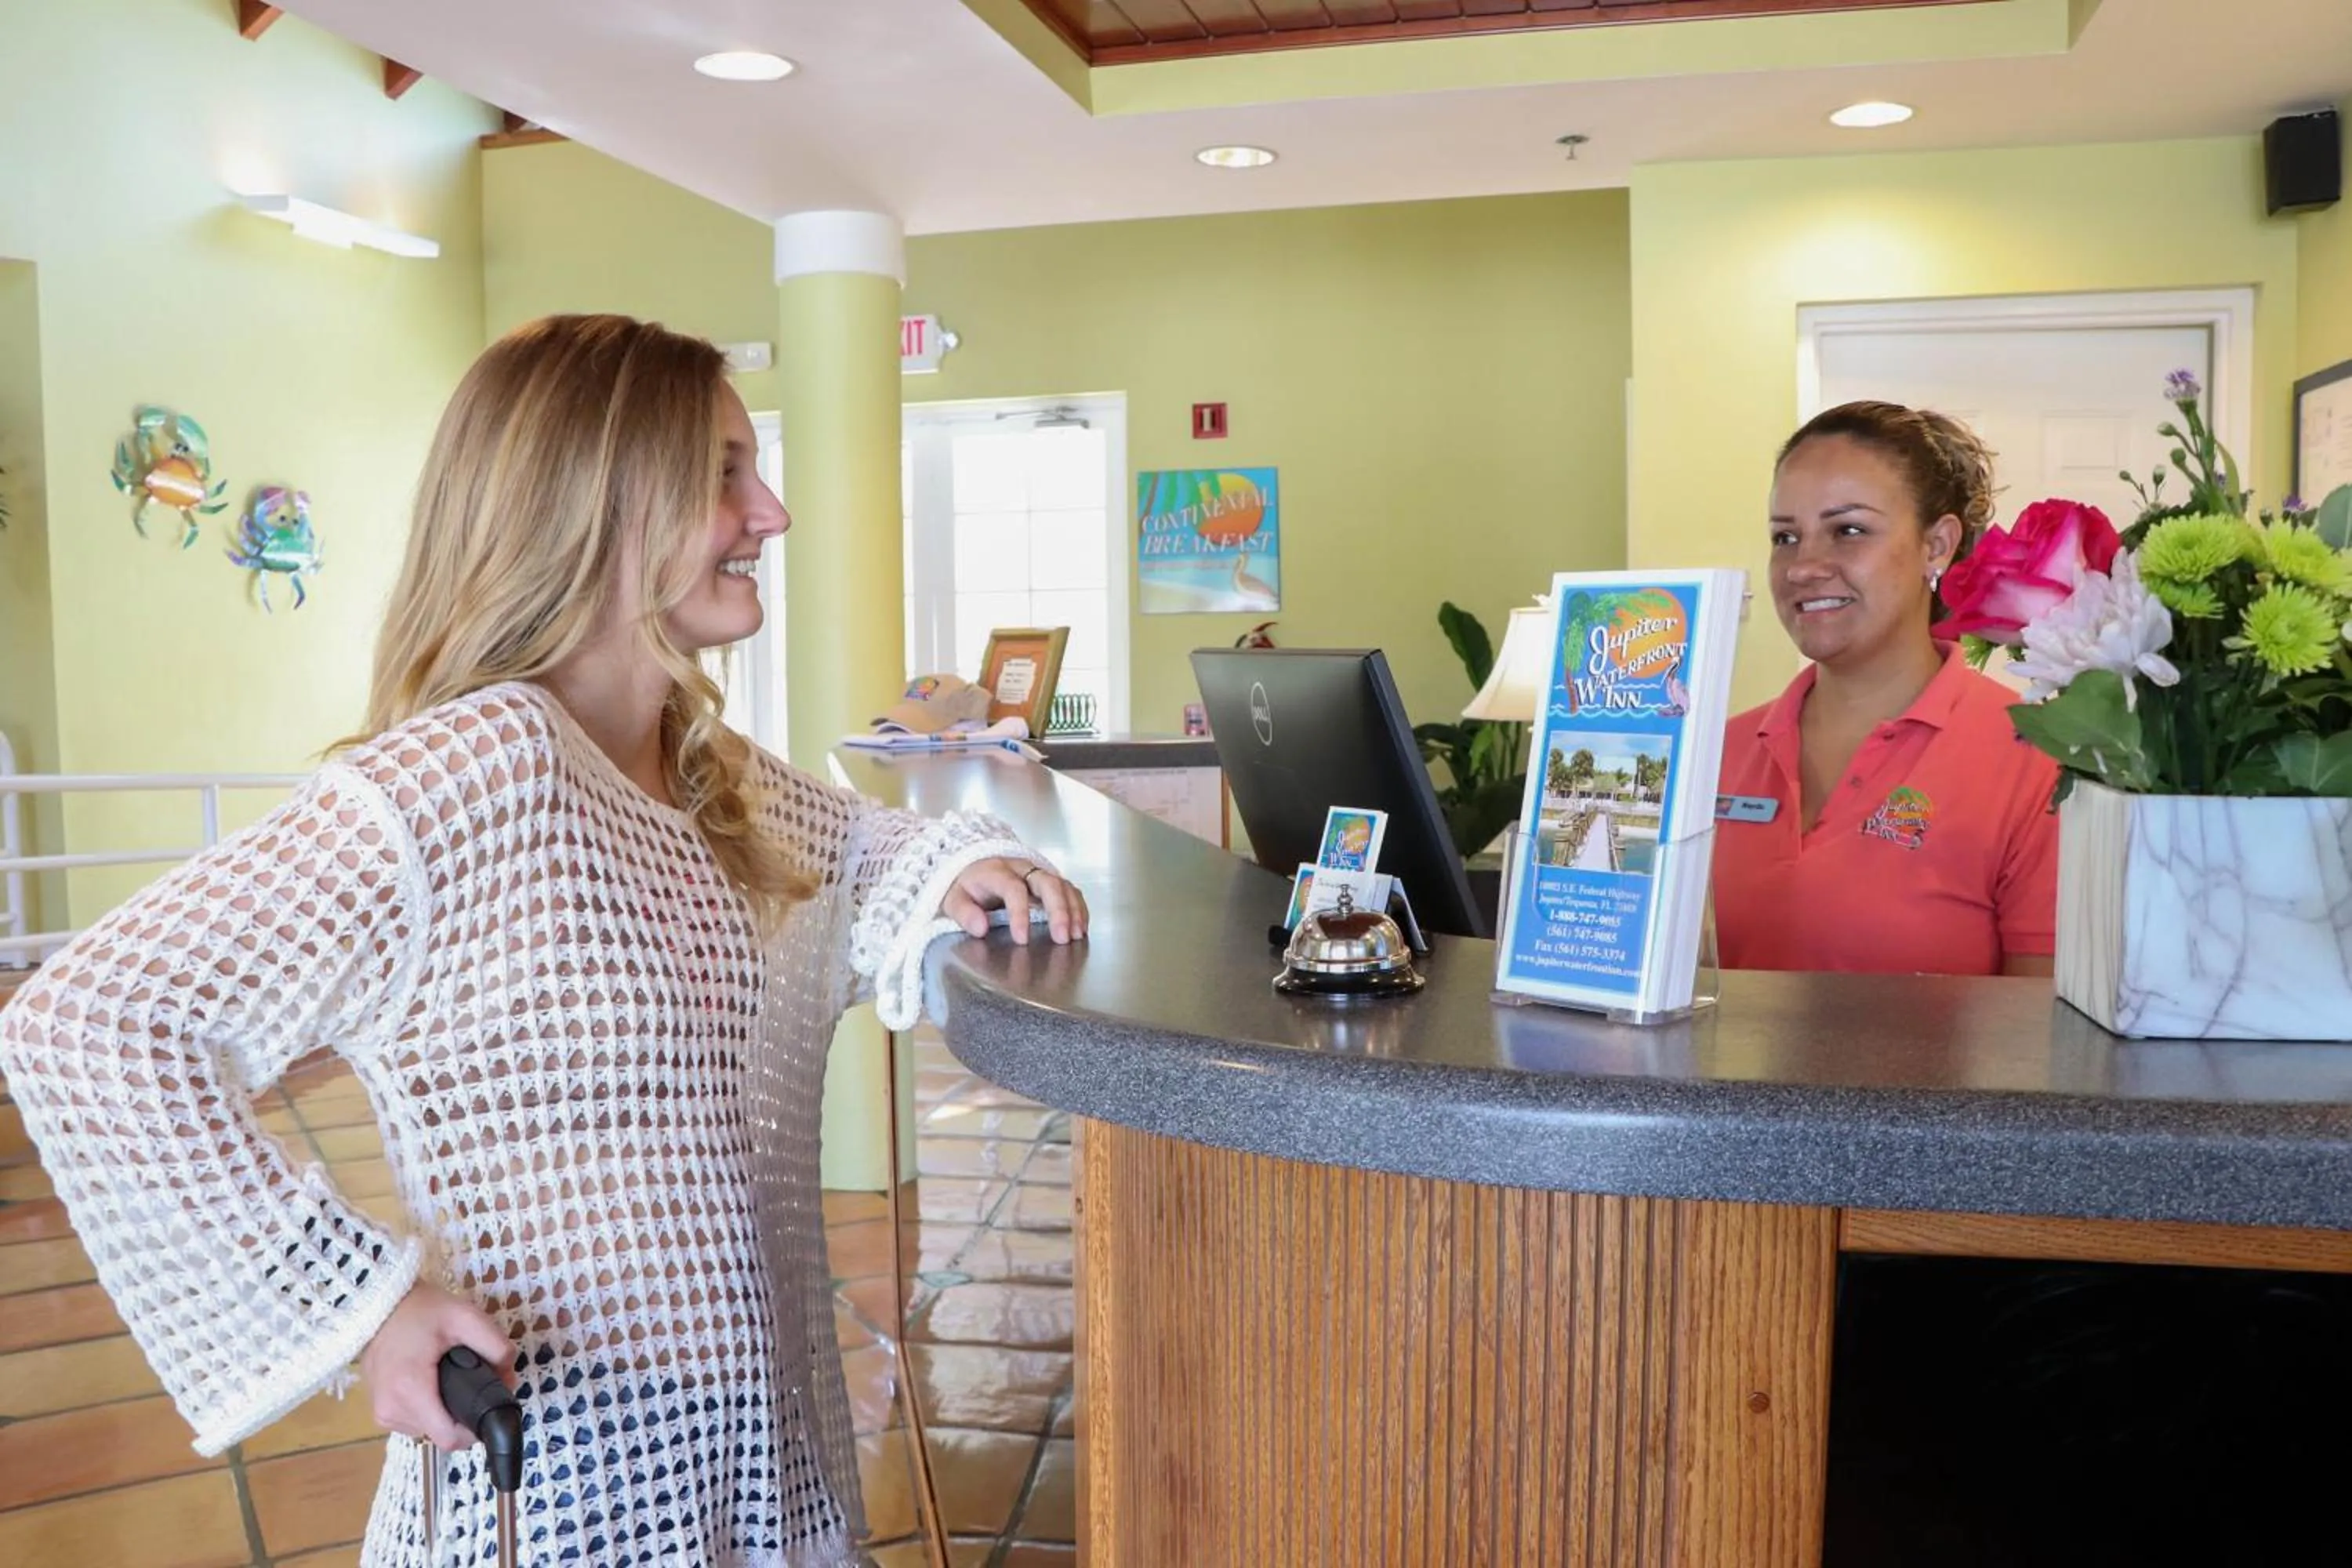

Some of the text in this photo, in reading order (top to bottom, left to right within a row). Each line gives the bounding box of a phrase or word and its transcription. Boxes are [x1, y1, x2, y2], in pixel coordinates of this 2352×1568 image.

[1143, 532, 1273, 554] BREAKFAST
[1589, 617, 1678, 675] Jupiter
[1574, 642, 1687, 704] WATERFRONT
[1602, 685, 1642, 709] INN
[1535, 940, 1553, 952] Fax
